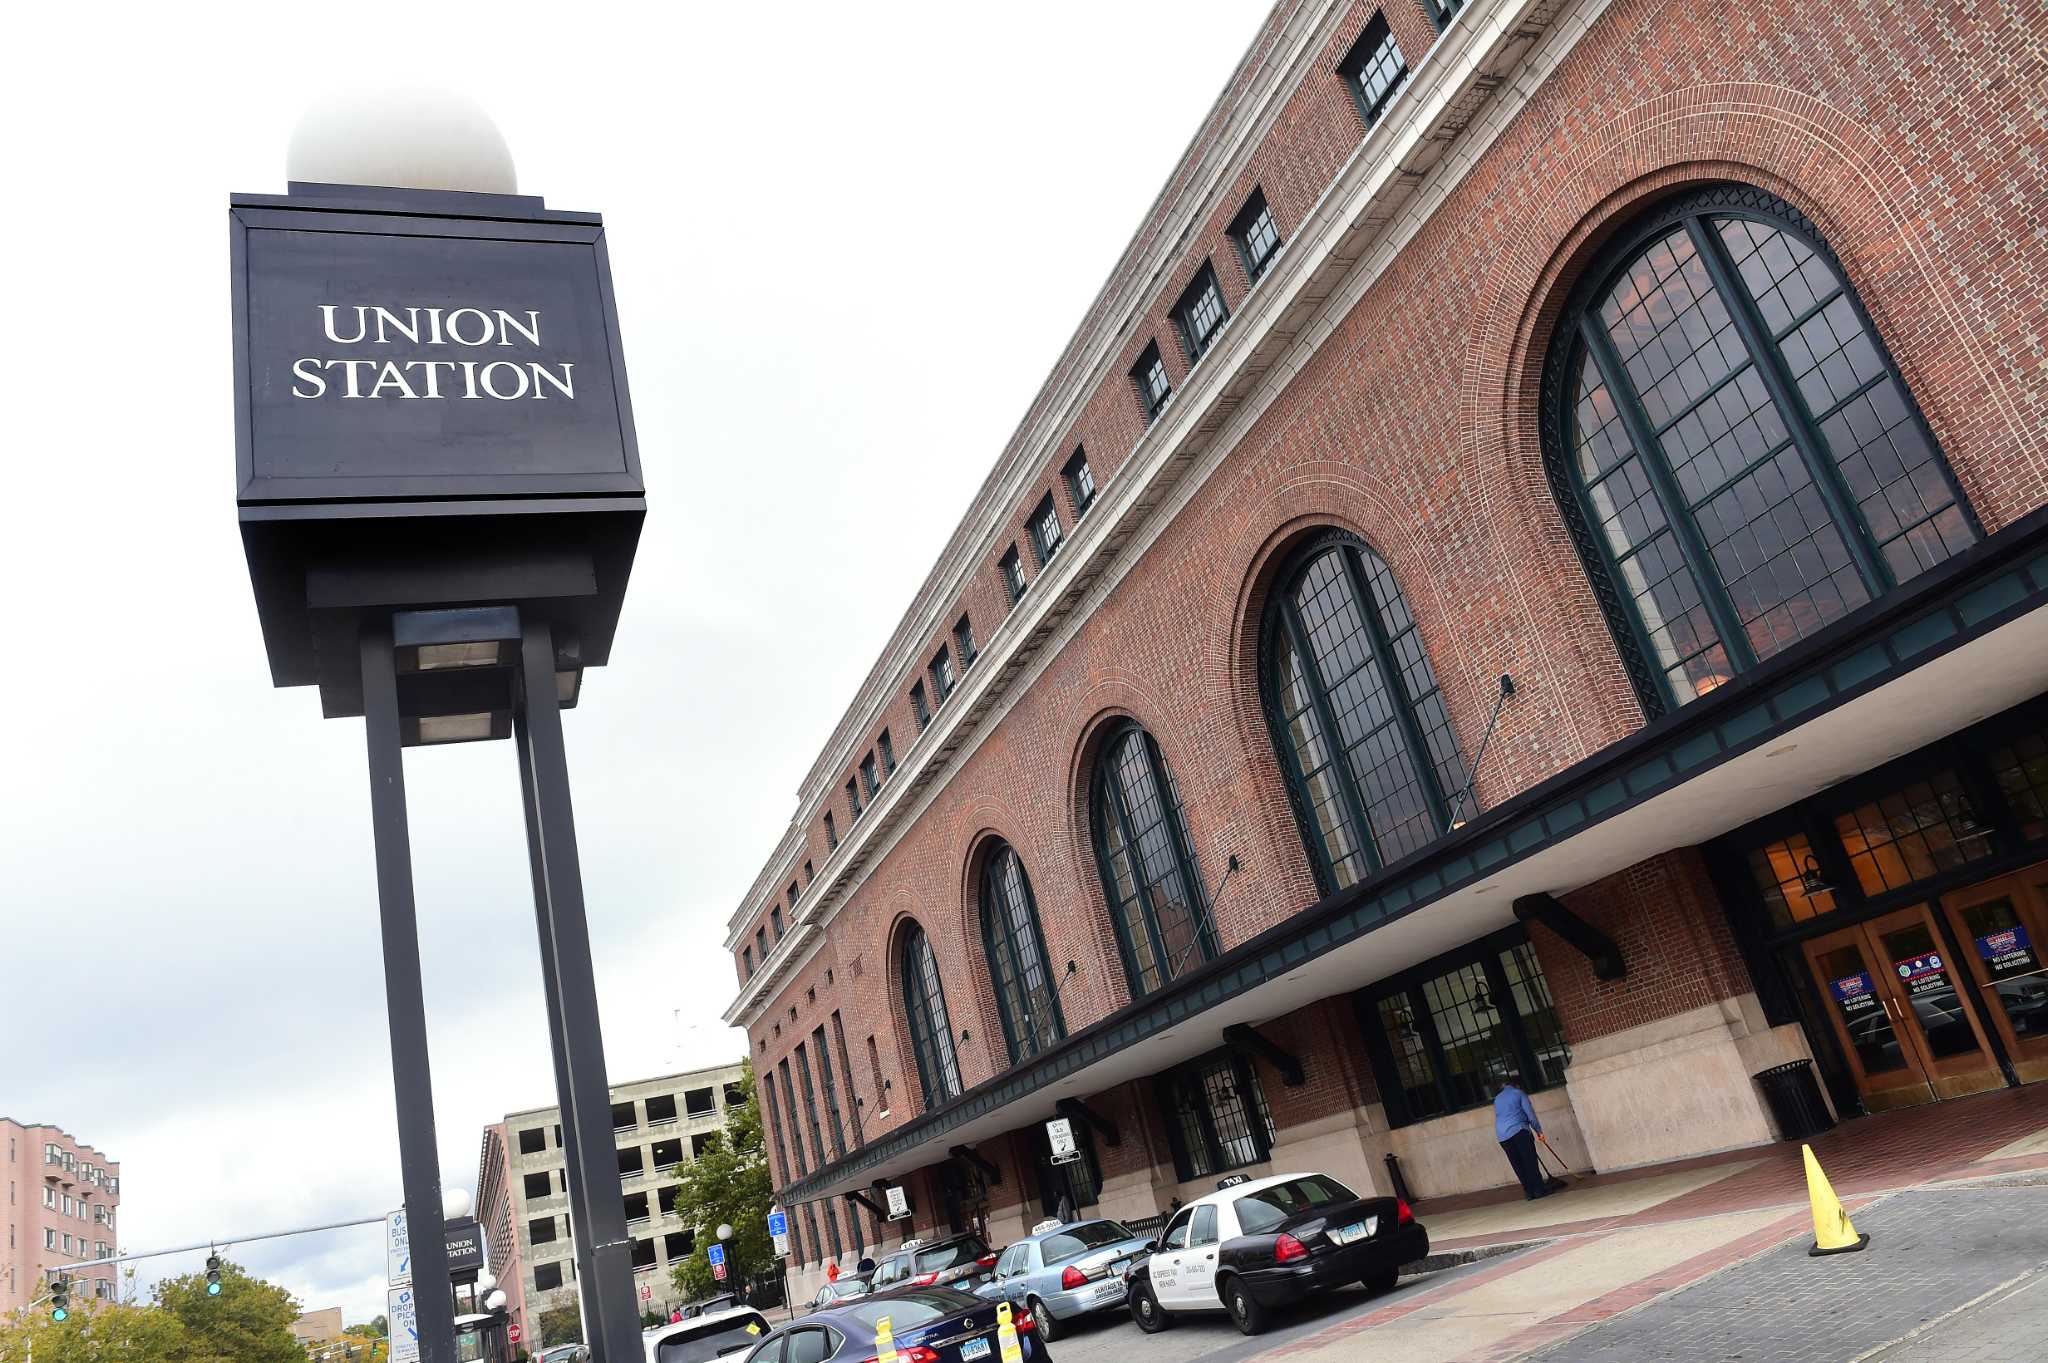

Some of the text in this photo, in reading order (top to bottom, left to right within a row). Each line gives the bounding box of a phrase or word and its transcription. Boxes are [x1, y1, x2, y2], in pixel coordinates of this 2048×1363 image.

[317, 305, 541, 346] UNION
[292, 358, 575, 400] STATION
[1224, 1175, 1243, 1187] TAXI
[392, 1226, 406, 1237] BUS
[394, 1237, 409, 1247] ONL
[446, 1239, 473, 1250] UNION
[447, 1245, 477, 1258] TATION
[391, 1303, 414, 1313] DROP
[509, 1329, 521, 1338] STOP
